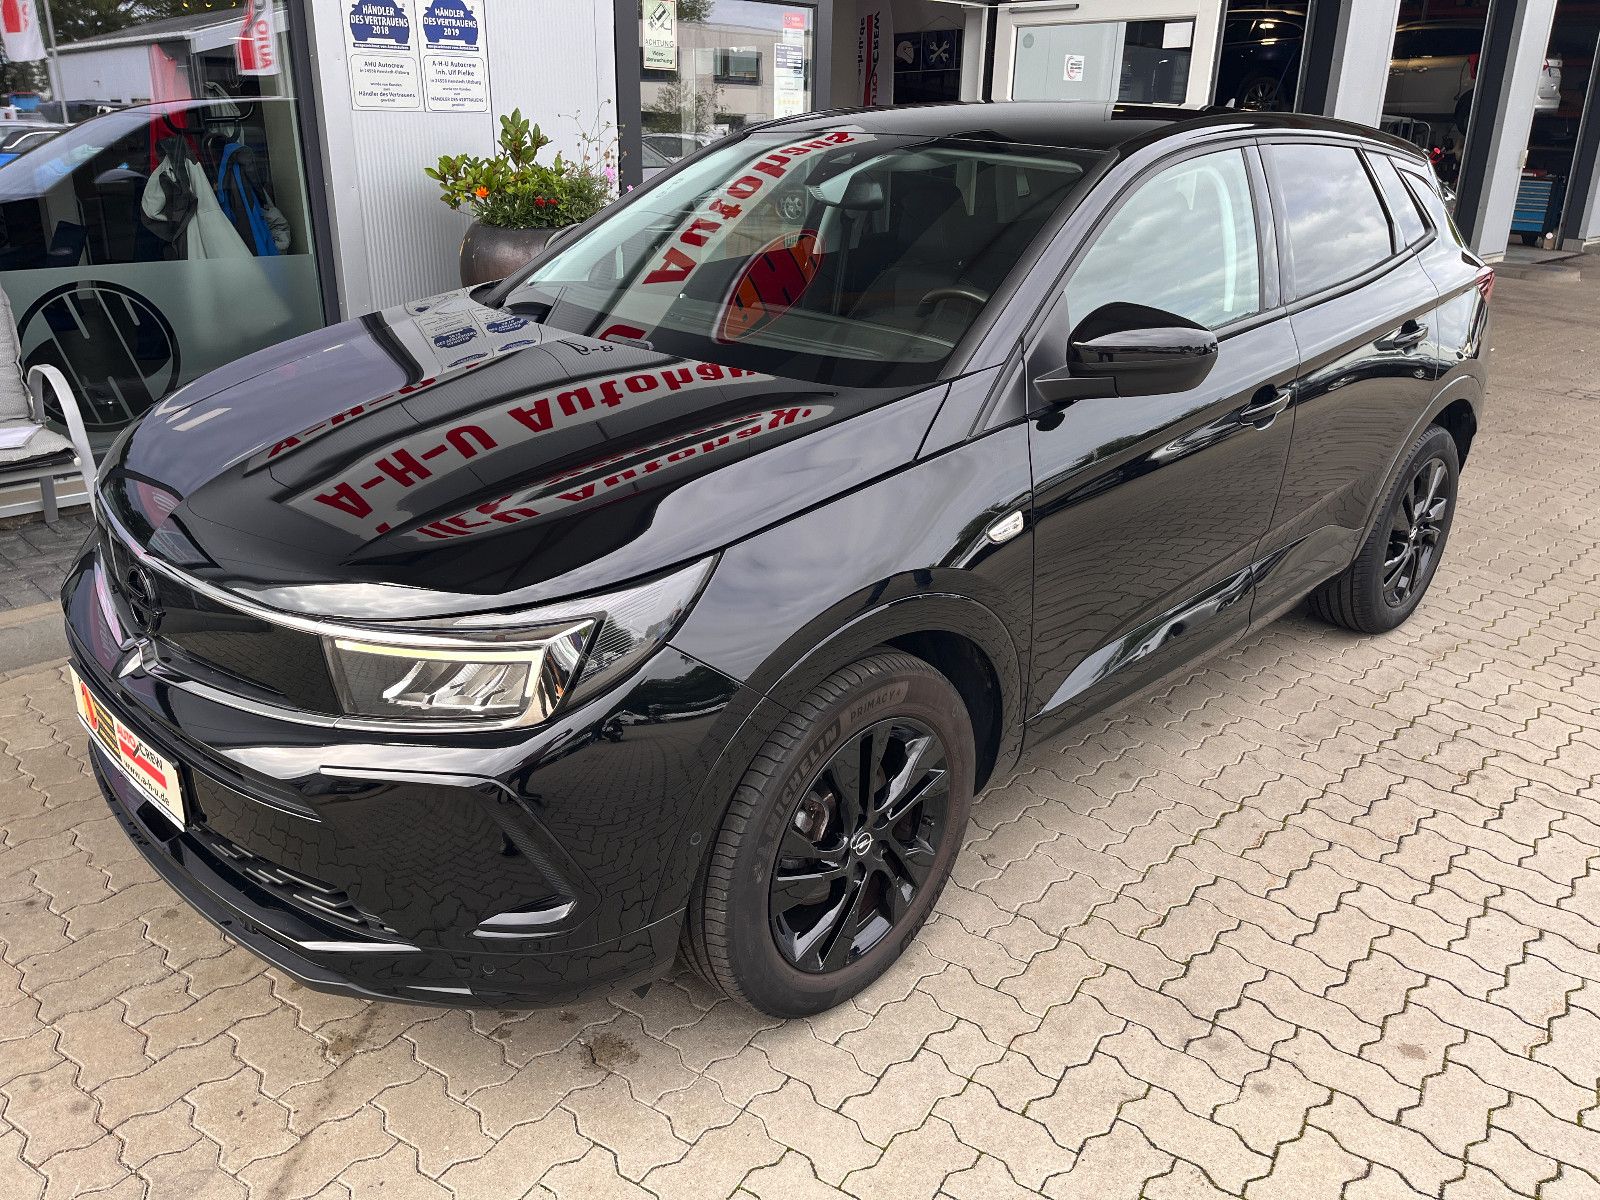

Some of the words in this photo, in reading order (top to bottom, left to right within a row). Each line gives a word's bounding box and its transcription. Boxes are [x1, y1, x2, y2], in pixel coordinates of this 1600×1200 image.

[362, 4, 395, 16] HÄNDLER
[434, 8, 465, 18] HÄNDLER
[350, 14, 364, 24] DES
[364, 16, 409, 27] VERTRAUENS
[424, 17, 437, 25] DES
[436, 18, 477, 29] VERTRAUENS
[372, 25, 389, 35] 2018
[443, 28, 460, 36] 2019
[645, 39, 675, 48] ACHTUNG
[850, 689, 894, 723] PRIMACY
[138, 740, 163, 771] CREW
[764, 724, 841, 840] MICHELIN
